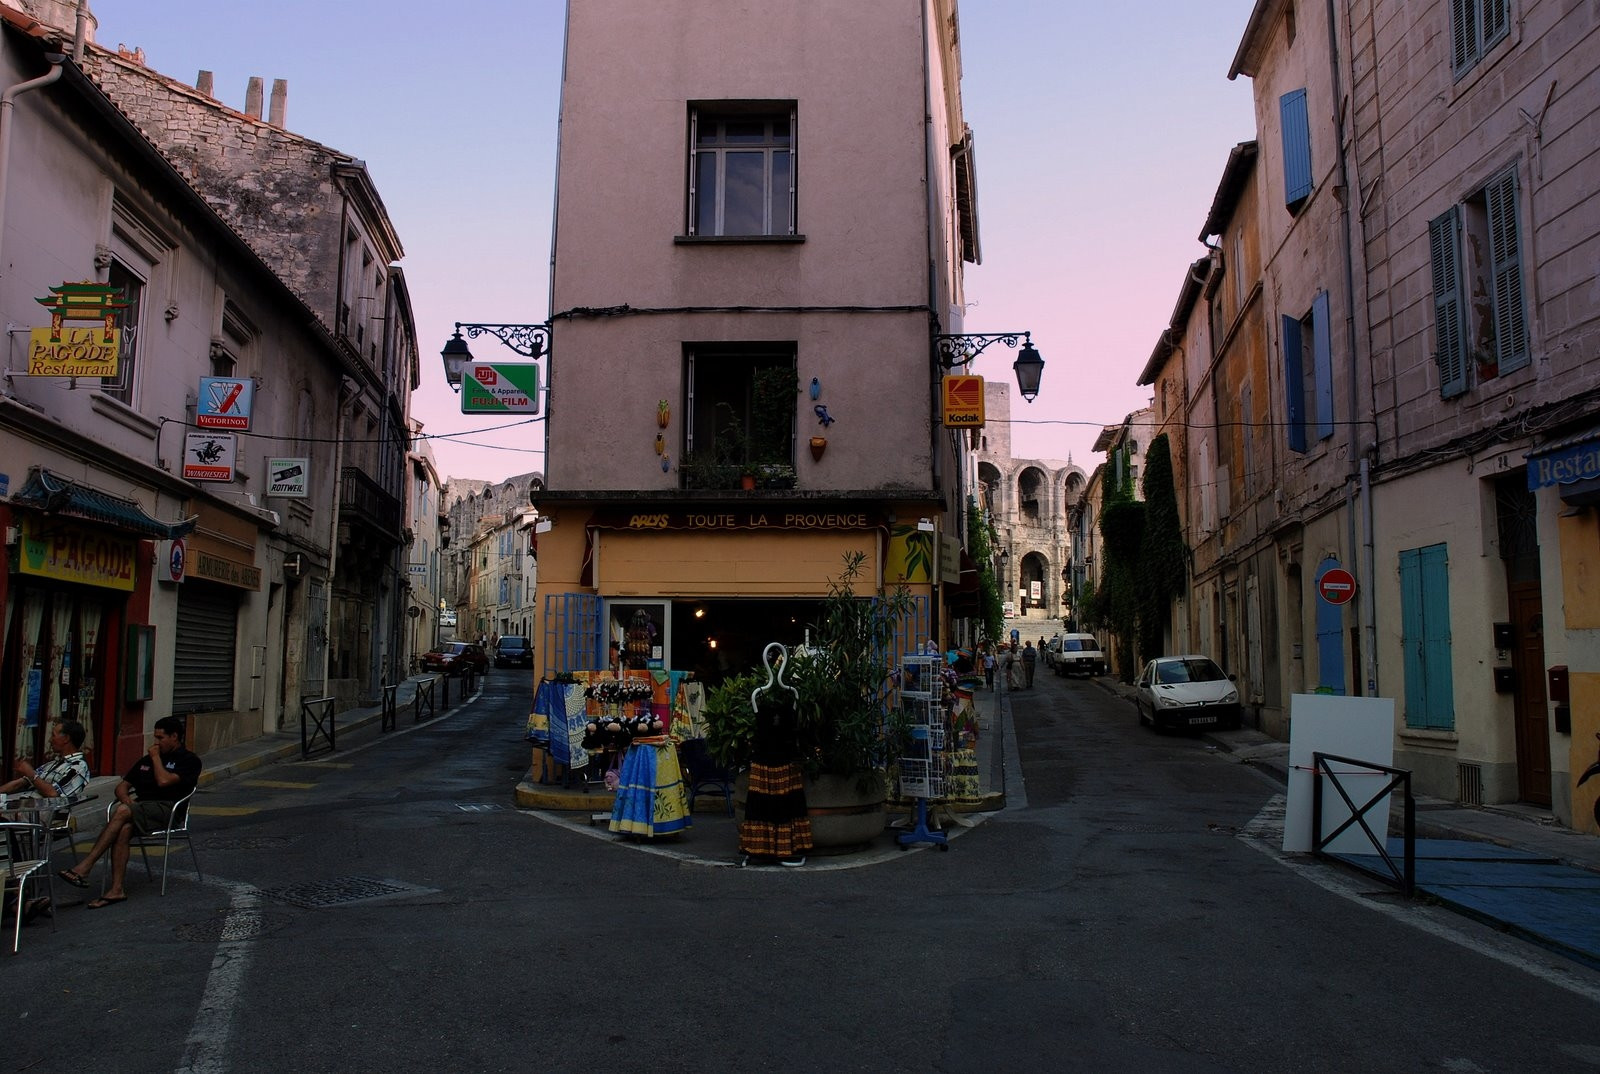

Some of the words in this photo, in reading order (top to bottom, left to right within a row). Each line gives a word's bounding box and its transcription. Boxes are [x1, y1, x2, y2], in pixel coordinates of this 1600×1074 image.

[69, 330, 95, 345] LA
[32, 345, 116, 361] PAGODE
[30, 361, 115, 375] Restaurant
[472, 397, 498, 405] FUJI
[501, 397, 528, 406] FILM
[948, 413, 979, 423] Kodak
[1536, 450, 1600, 483] Resta
[186, 469, 229, 479] WINCHESTER
[270, 484, 303, 492] ROTTWEIL
[686, 514, 736, 527] TOUTE
[750, 514, 768, 526] LA
[785, 514, 867, 527] PROVENCE
[53, 533, 131, 580] PAGODE
